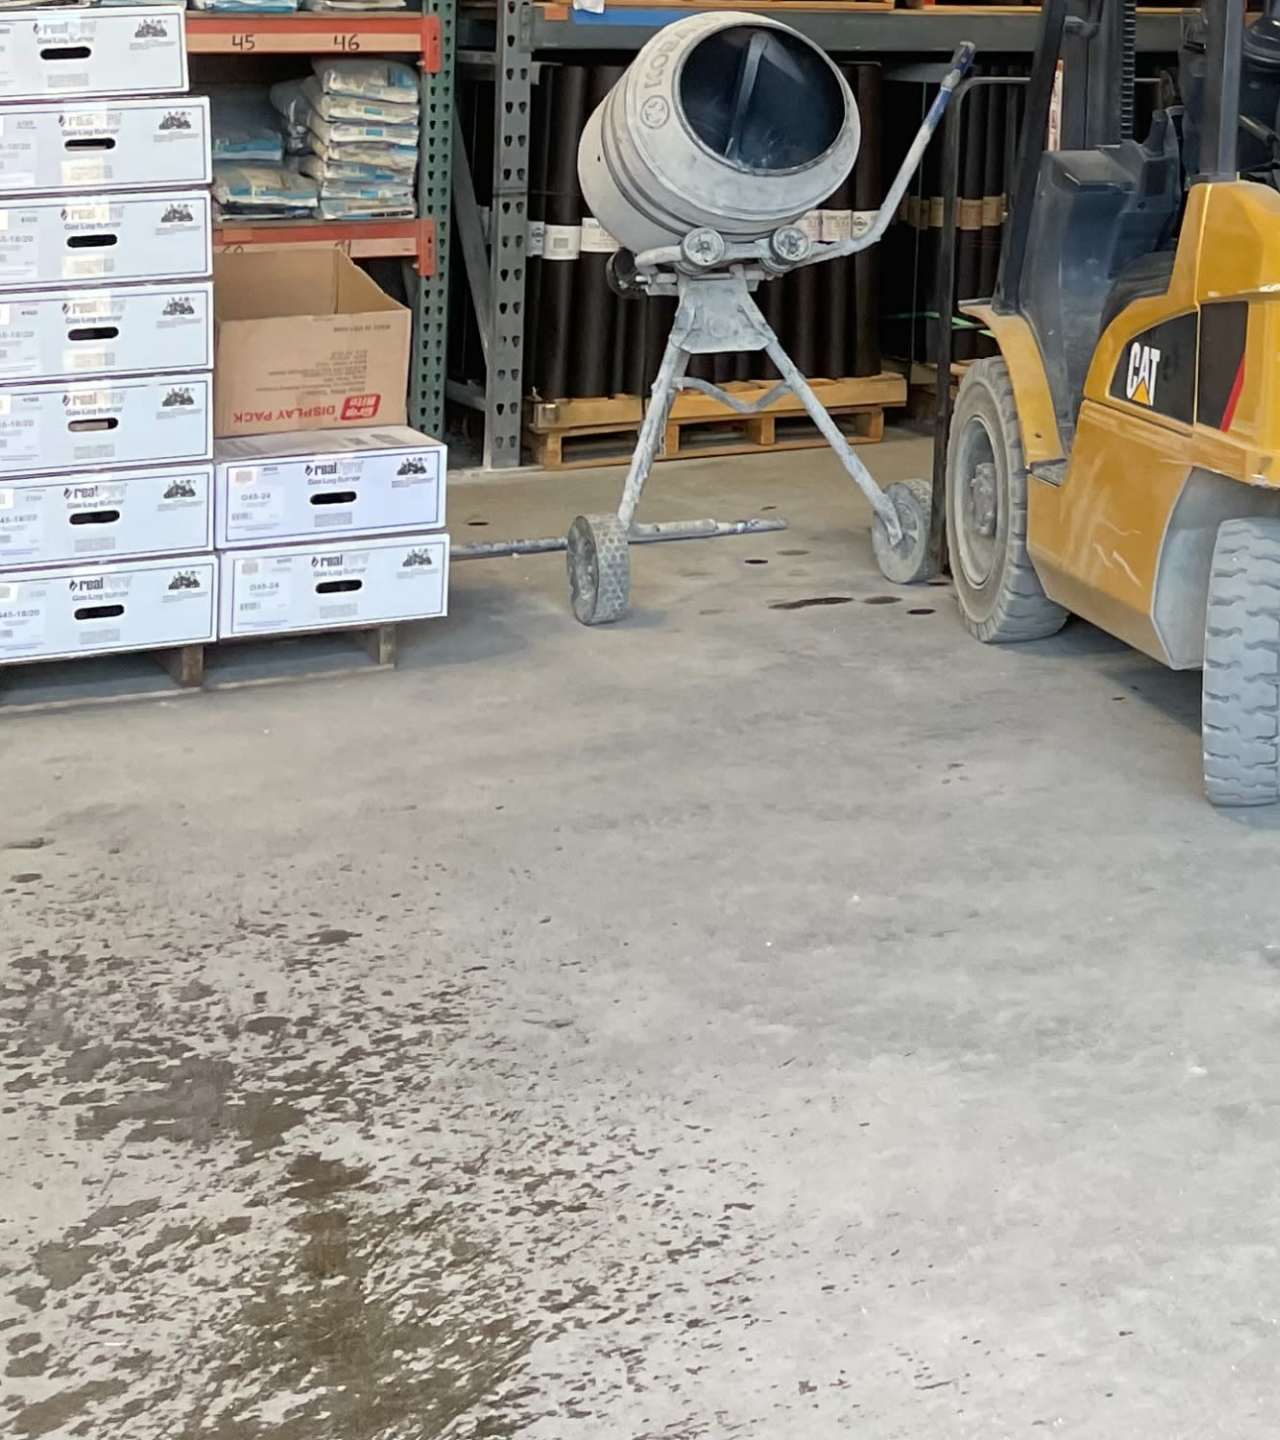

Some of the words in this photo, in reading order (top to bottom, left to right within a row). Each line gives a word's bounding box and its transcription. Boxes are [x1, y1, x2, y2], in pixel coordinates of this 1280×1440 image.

[232, 34, 256, 51] 45
[333, 33, 360, 51] 46
[1126, 342, 1161, 407] CAT
[233, 410, 273, 423] PACK
[276, 405, 335, 420] DISPLAY
